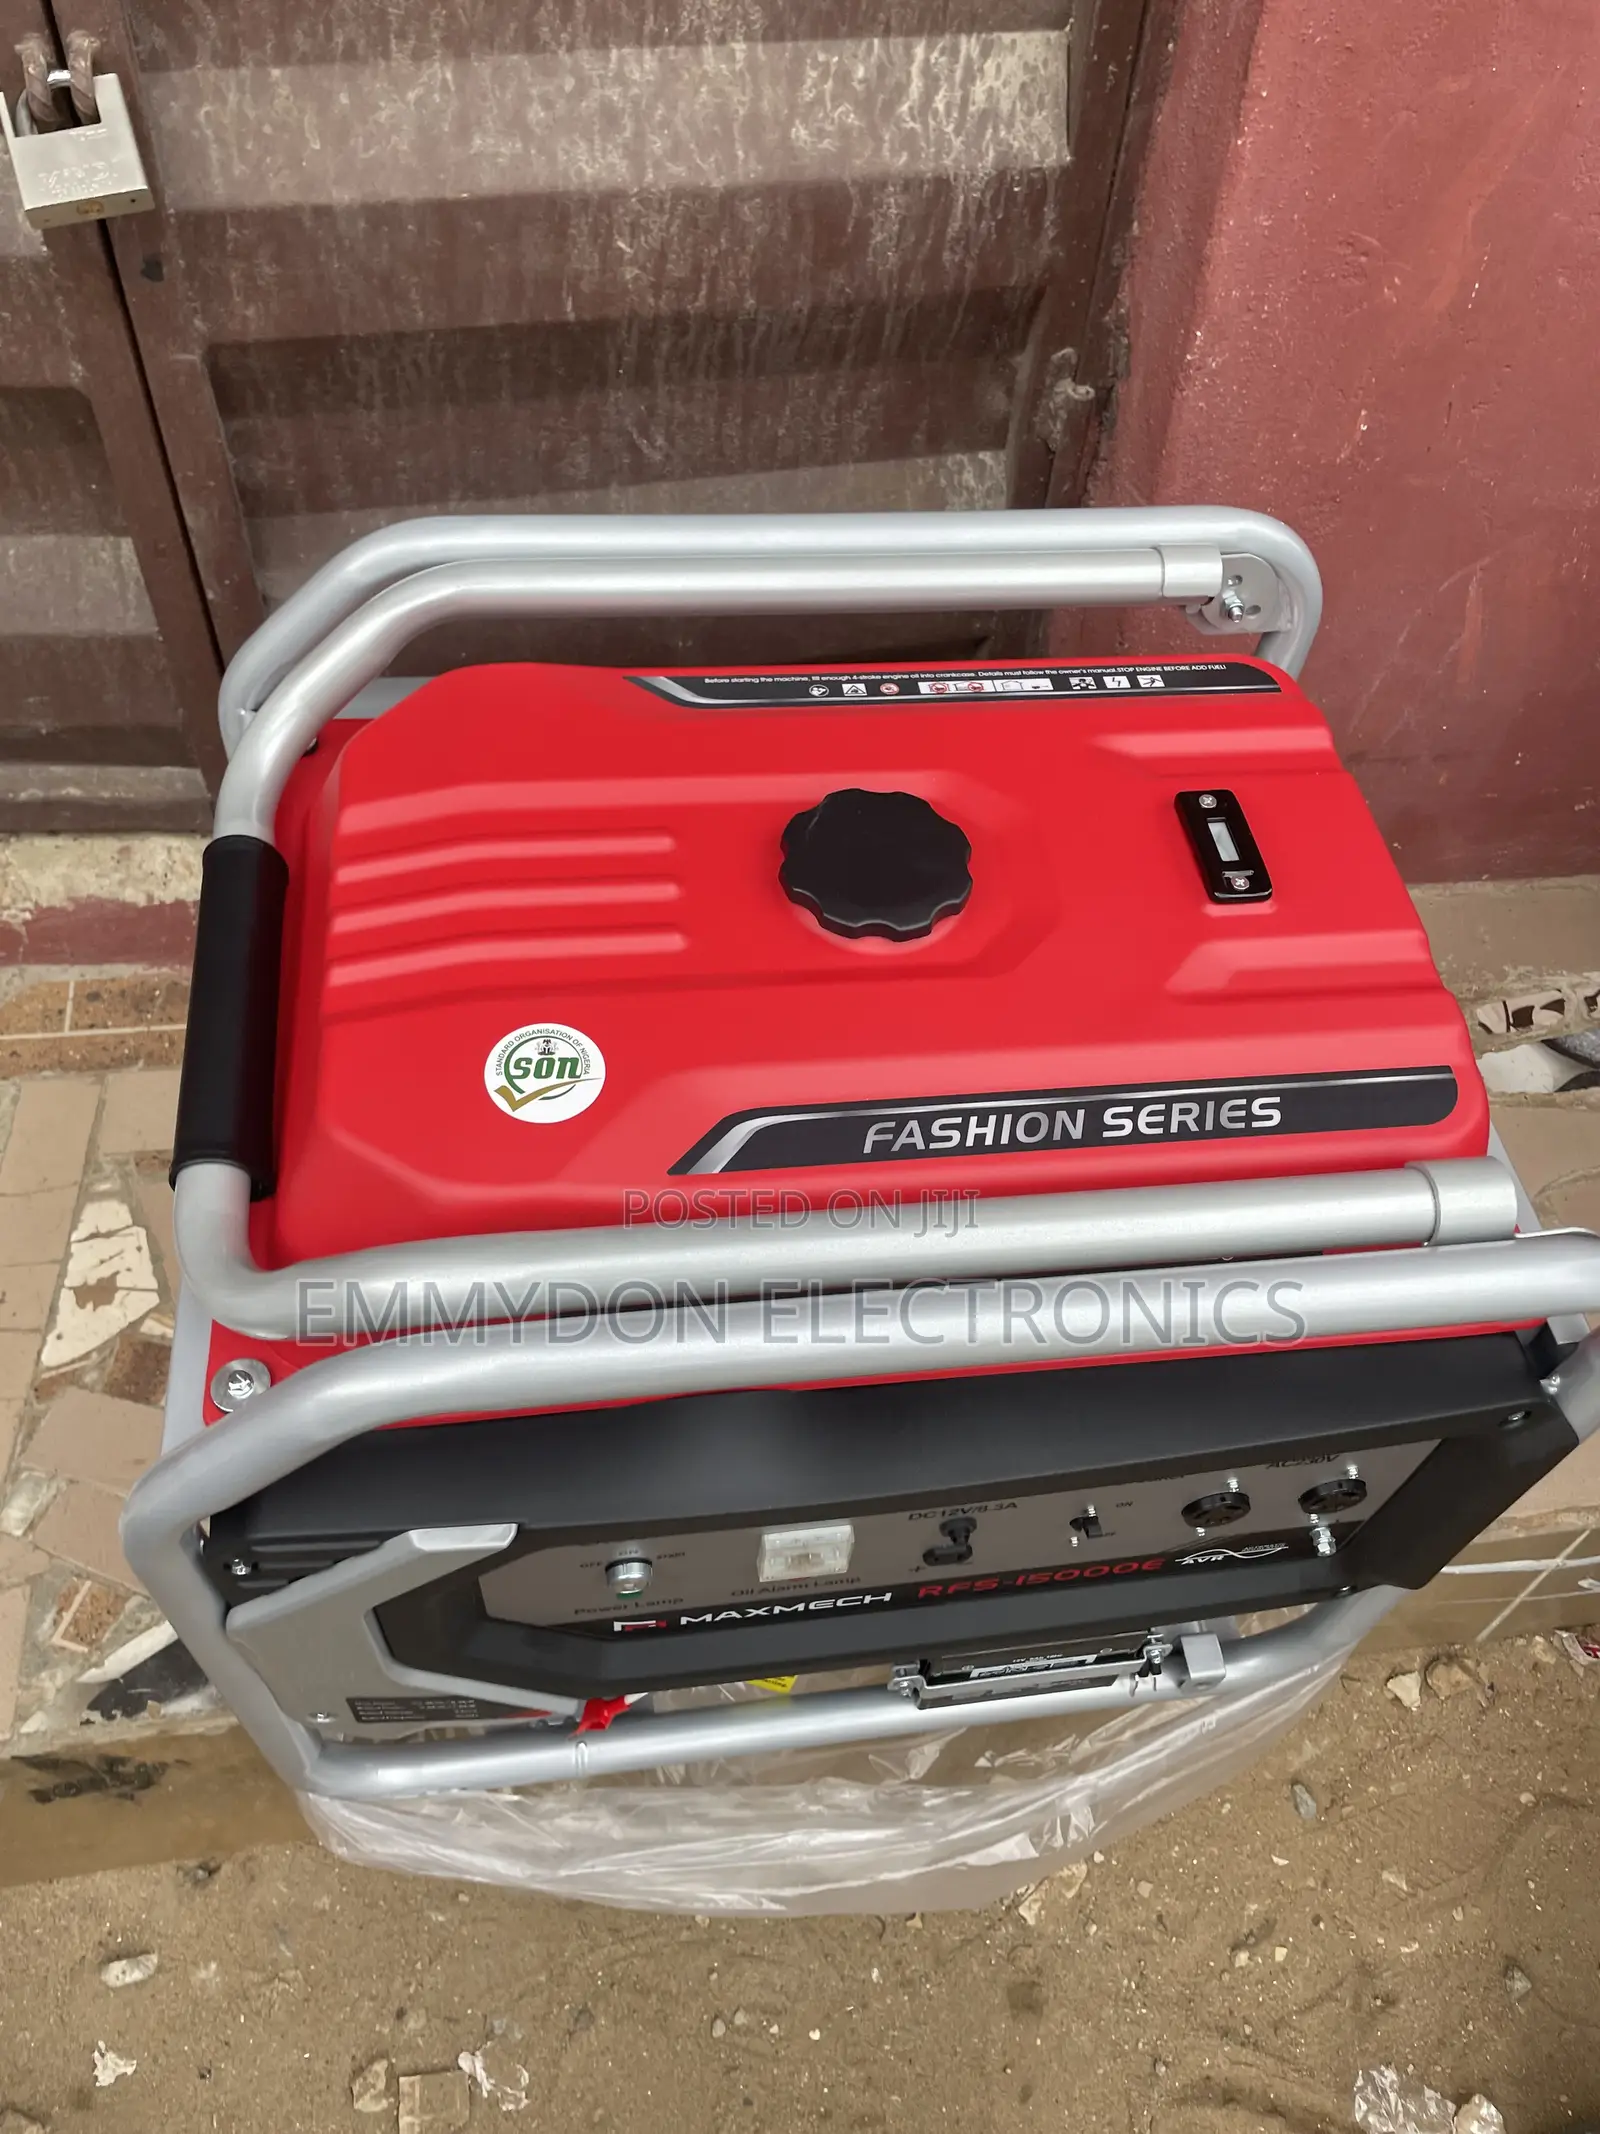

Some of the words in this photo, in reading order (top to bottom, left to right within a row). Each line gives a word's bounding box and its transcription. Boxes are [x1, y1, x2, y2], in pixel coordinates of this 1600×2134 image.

[495, 1039, 515, 1077] STANDARD
[514, 1028, 574, 1042] ORGANISATION
[572, 1039, 584, 1048] OF
[580, 1047, 591, 1076] NIGERIA
[862, 1109, 1085, 1153] FASHION
[1102, 1096, 1282, 1138] SERIES
[680, 1592, 893, 1626] MAXMECH
[918, 1558, 1167, 1600] RFS-15000E
